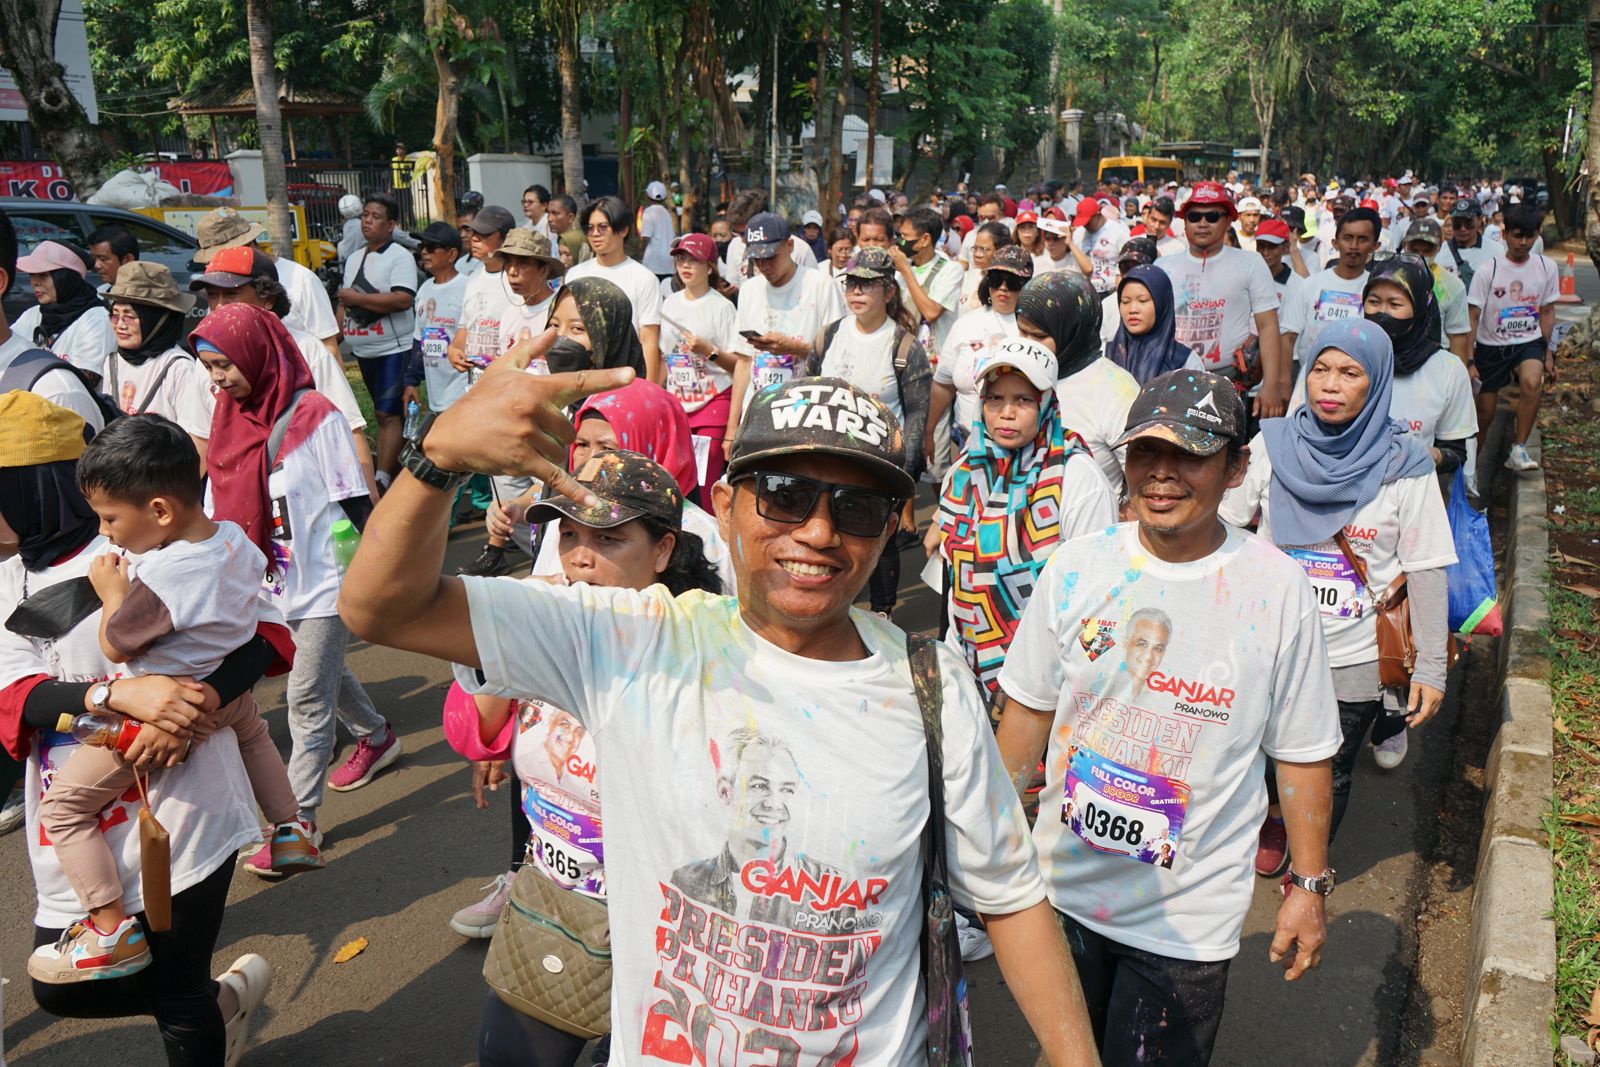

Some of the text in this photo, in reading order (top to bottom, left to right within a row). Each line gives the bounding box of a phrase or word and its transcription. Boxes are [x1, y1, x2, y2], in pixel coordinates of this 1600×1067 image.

[1327, 307, 1349, 319] 0413
[1507, 320, 1528, 330] 0064
[771, 385, 888, 431] STAR
[771, 404, 888, 446] WARS
[1315, 561, 1345, 571] COLOR
[1146, 671, 1236, 709] GANJAR
[1174, 702, 1230, 721] PRANOWO
[1090, 765, 1112, 784] FULL
[1113, 777, 1157, 797] COLOR
[1103, 784, 1140, 804] BOGOR
[548, 812, 582, 836] COLOR
[1084, 801, 1145, 846] 0368
[740, 858, 889, 912] GANJAR
[793, 910, 883, 931] PRANOWO
